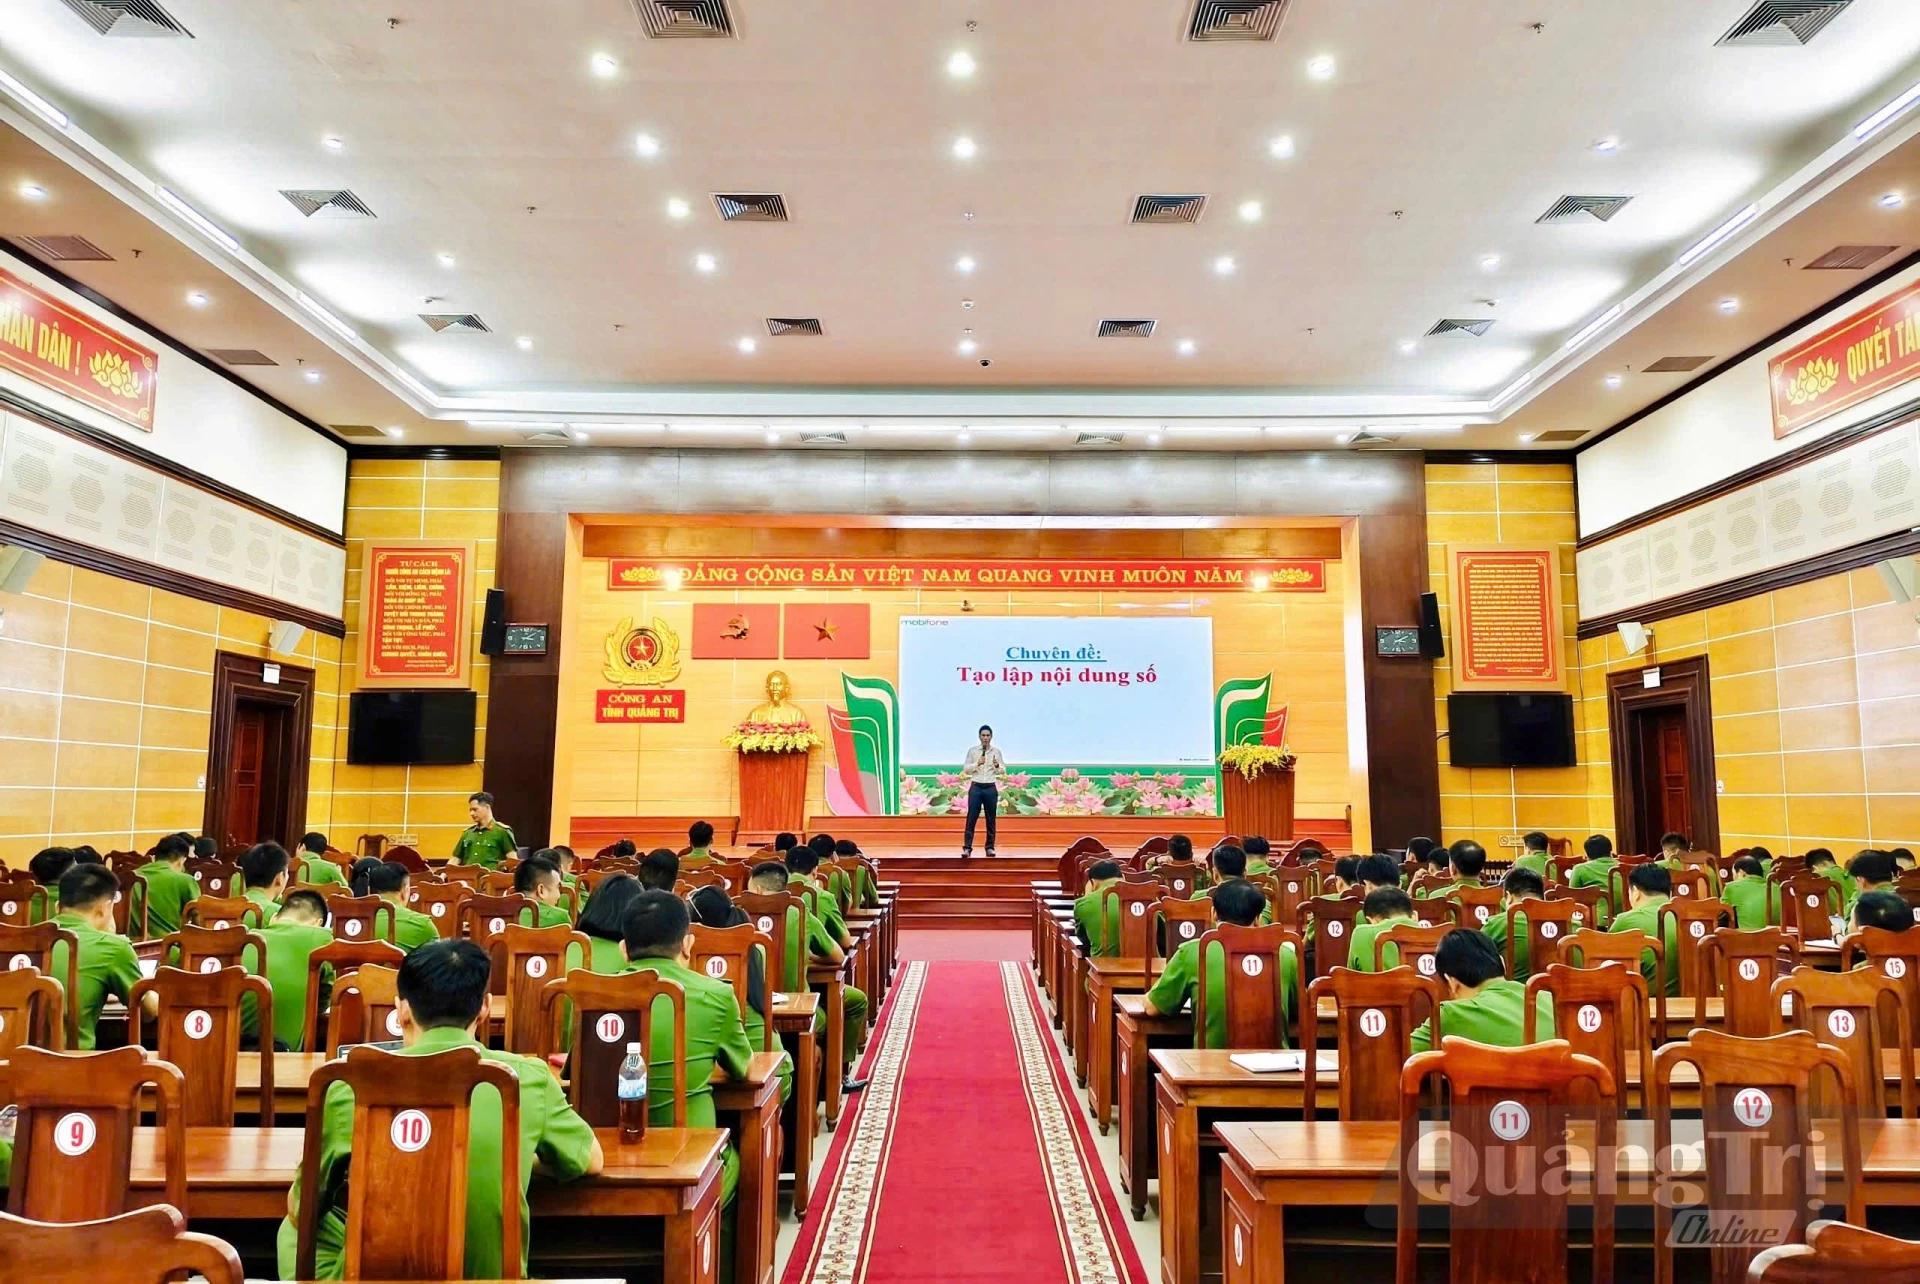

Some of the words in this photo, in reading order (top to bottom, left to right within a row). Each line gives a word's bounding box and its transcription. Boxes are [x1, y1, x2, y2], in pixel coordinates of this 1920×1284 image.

[37, 321, 71, 371] DÂN
[1847, 318, 1892, 384] QUYẾT
[678, 562, 738, 582] ĐẢNG
[745, 564, 805, 585] CỘNG
[811, 563, 855, 582] SẢN
[863, 564, 915, 586] VIỆT
[921, 568, 971, 582] NAM
[977, 569, 1052, 584] QUANG
[1059, 569, 1115, 583] VINH
[1122, 566, 1186, 583] MUÔN
[1193, 566, 1244, 583] NĂM
[1006, 646, 1071, 661] Chuyên
[1076, 644, 1101, 660] đề:
[957, 666, 995, 686] Tạo
[1002, 667, 1033, 686] lập
[1040, 667, 1071, 686] nội
[1078, 667, 1130, 687] dung
[1136, 663, 1157, 683] số
[608, 692, 646, 703] CÔNG
[652, 695, 672, 703] AN
[602, 704, 624, 717] TỈNH
[627, 704, 660, 718] QUẢNG
[663, 707, 679, 719] TRỊ
[7, 903, 13, 913] 5
[436, 905, 442, 914] 7
[1133, 905, 1142, 914] 11
[1478, 909, 1486, 917] 14
[350, 922, 357, 933] 7
[495, 921, 501, 931] 8
[761, 920, 770, 928] 10
[1183, 925, 1193, 935] 19
[1331, 924, 1340, 934] 12
[1545, 926, 1555, 935] 14
[1693, 925, 1702, 935] 15
[209, 962, 216, 972] 7
[534, 960, 541, 974] 9
[711, 961, 723, 974] 10
[1247, 959, 1258, 972] 11
[1422, 958, 1434, 971] 12
[1743, 963, 1756, 976] 14
[1889, 961, 1901, 975] 15
[195, 1016, 203, 1033] 8
[1365, 1015, 1380, 1032] 11
[1583, 1011, 1596, 1027] 12
[1835, 1015, 1850, 1032] 13
[602, 1019, 619, 1037] 10
[1742, 1095, 1765, 1120] 12
[1499, 1112, 1519, 1130] 11
[71, 1121, 84, 1147] 9
[400, 1118, 423, 1144] 10
